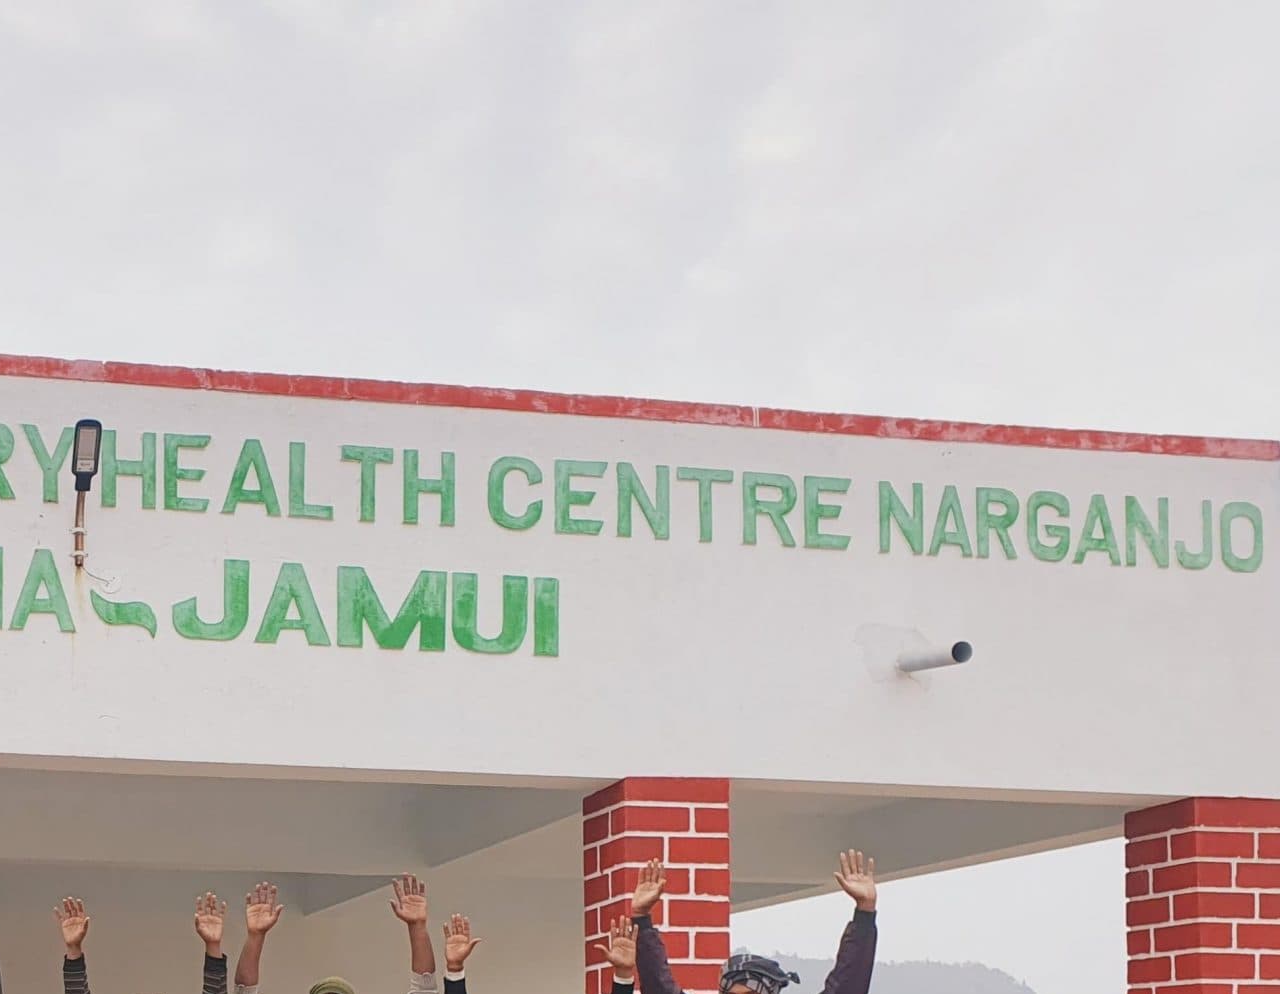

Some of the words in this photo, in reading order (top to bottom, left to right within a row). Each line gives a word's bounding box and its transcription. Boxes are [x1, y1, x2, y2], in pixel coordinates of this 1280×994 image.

[100, 429, 456, 525] HEALTH
[486, 455, 853, 550] CENTRE
[878, 480, 1263, 573] NARGANJO
[172, 558, 560, 657] JAMUI
